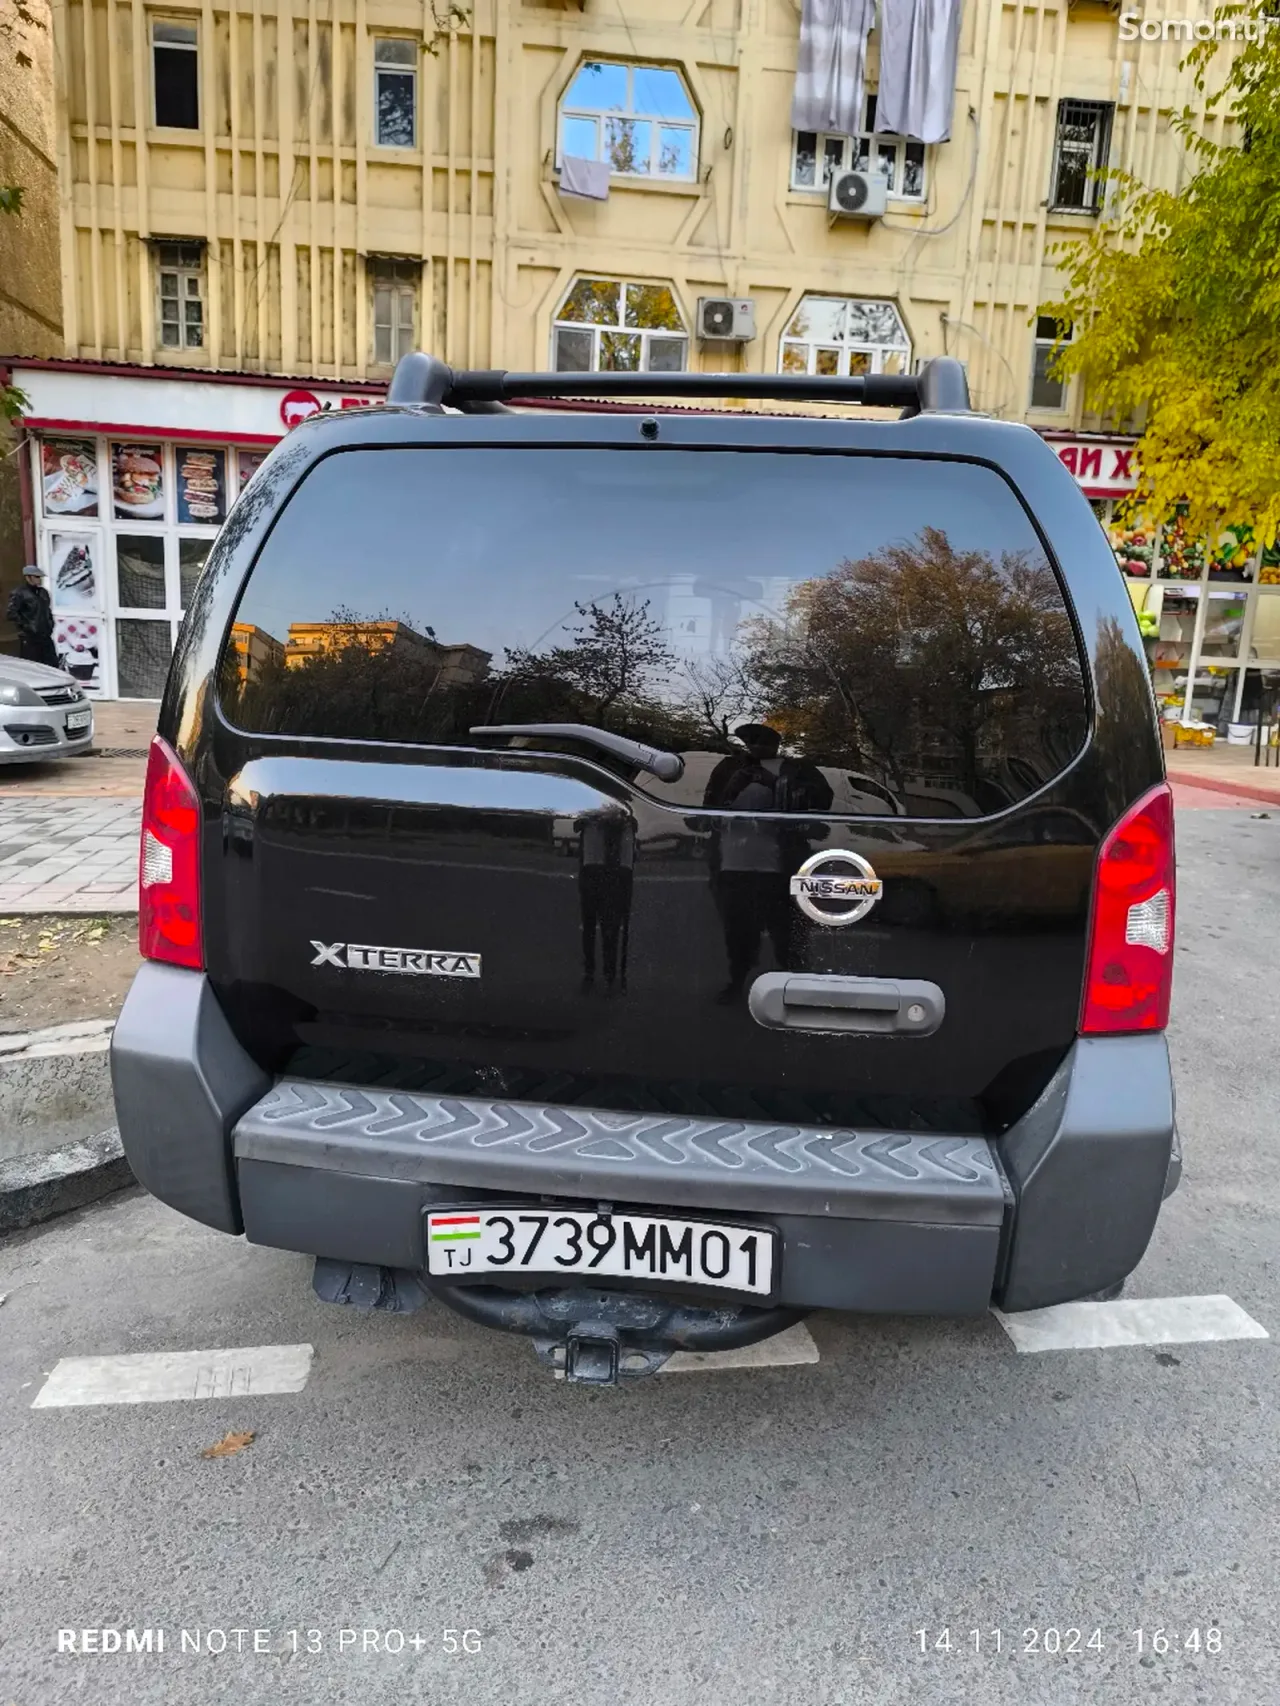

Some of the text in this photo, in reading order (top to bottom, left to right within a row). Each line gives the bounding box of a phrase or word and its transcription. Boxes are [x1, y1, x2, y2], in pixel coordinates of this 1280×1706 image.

[799, 880, 876, 896] NISSAN
[309, 940, 482, 978] XTERRA
[443, 1248, 472, 1268] TJ
[484, 1215, 758, 1287] 3739MM01
